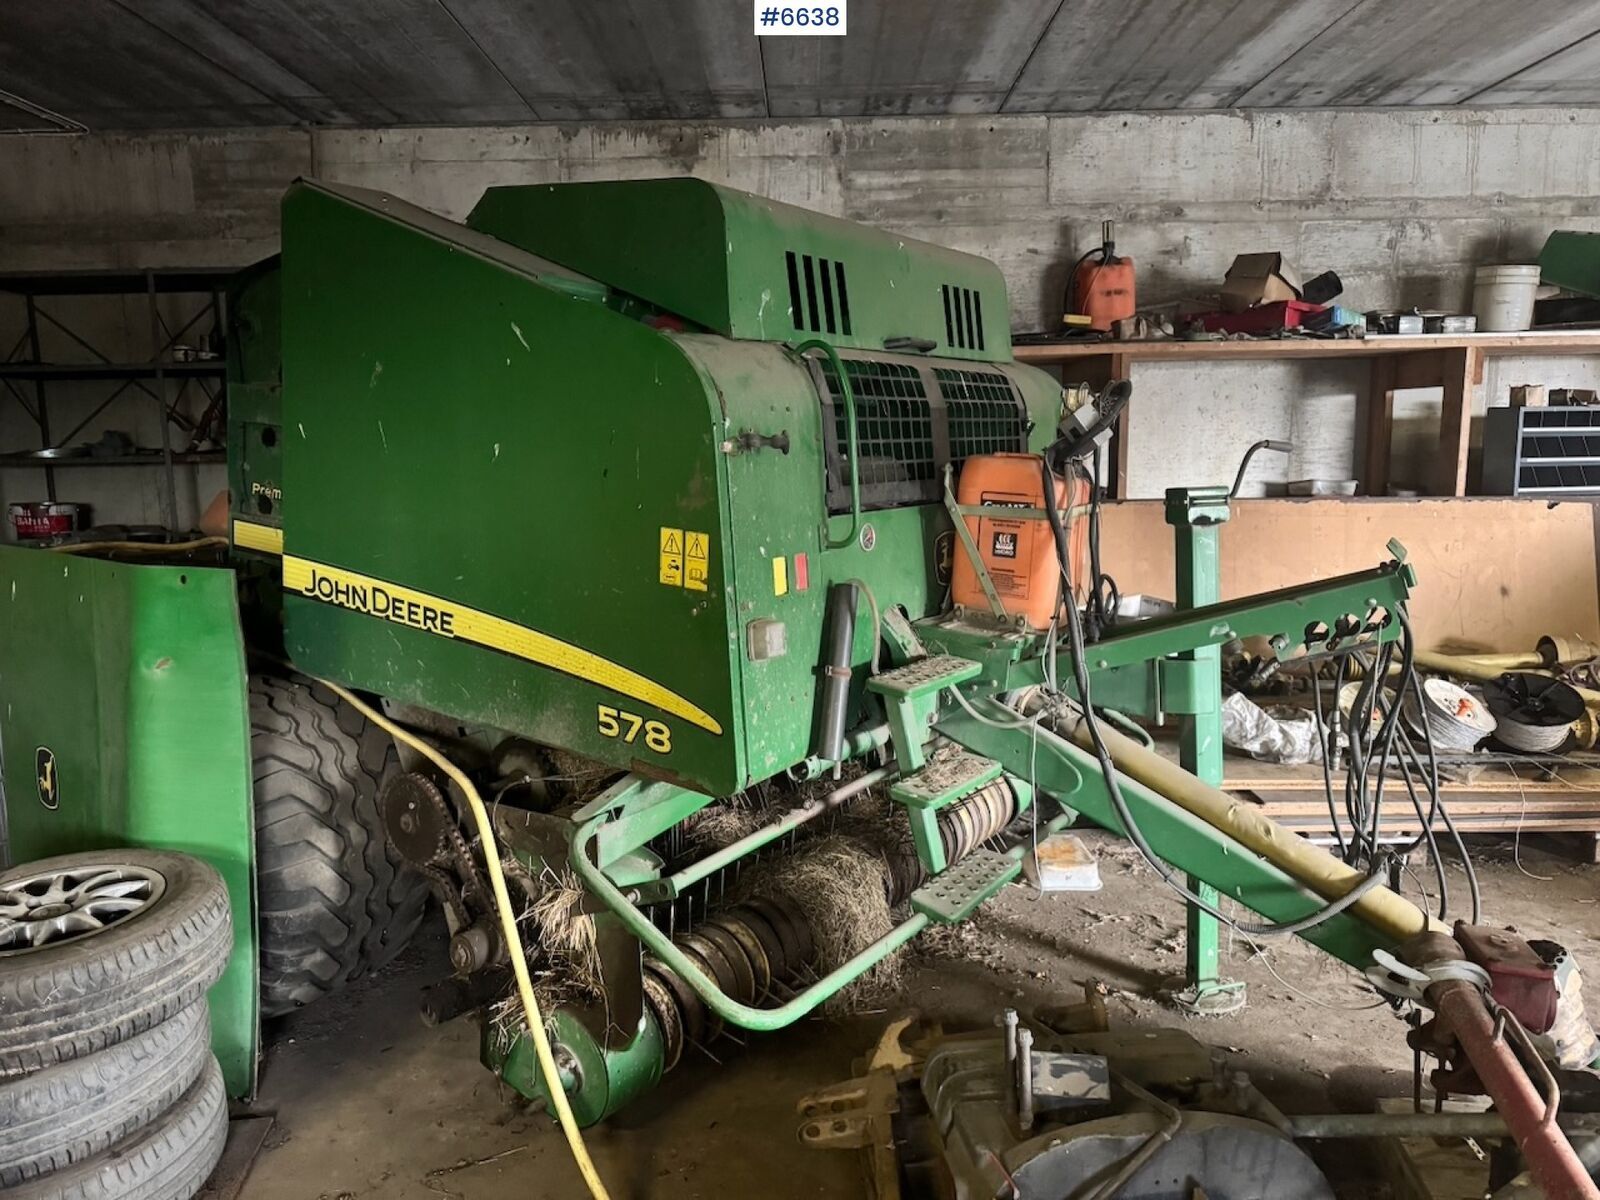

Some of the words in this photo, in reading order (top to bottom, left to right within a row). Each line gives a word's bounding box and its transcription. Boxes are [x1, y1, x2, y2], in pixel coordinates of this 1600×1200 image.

[304, 569, 367, 610] JOHN
[372, 586, 455, 636] DEERE
[598, 704, 672, 753] 578
